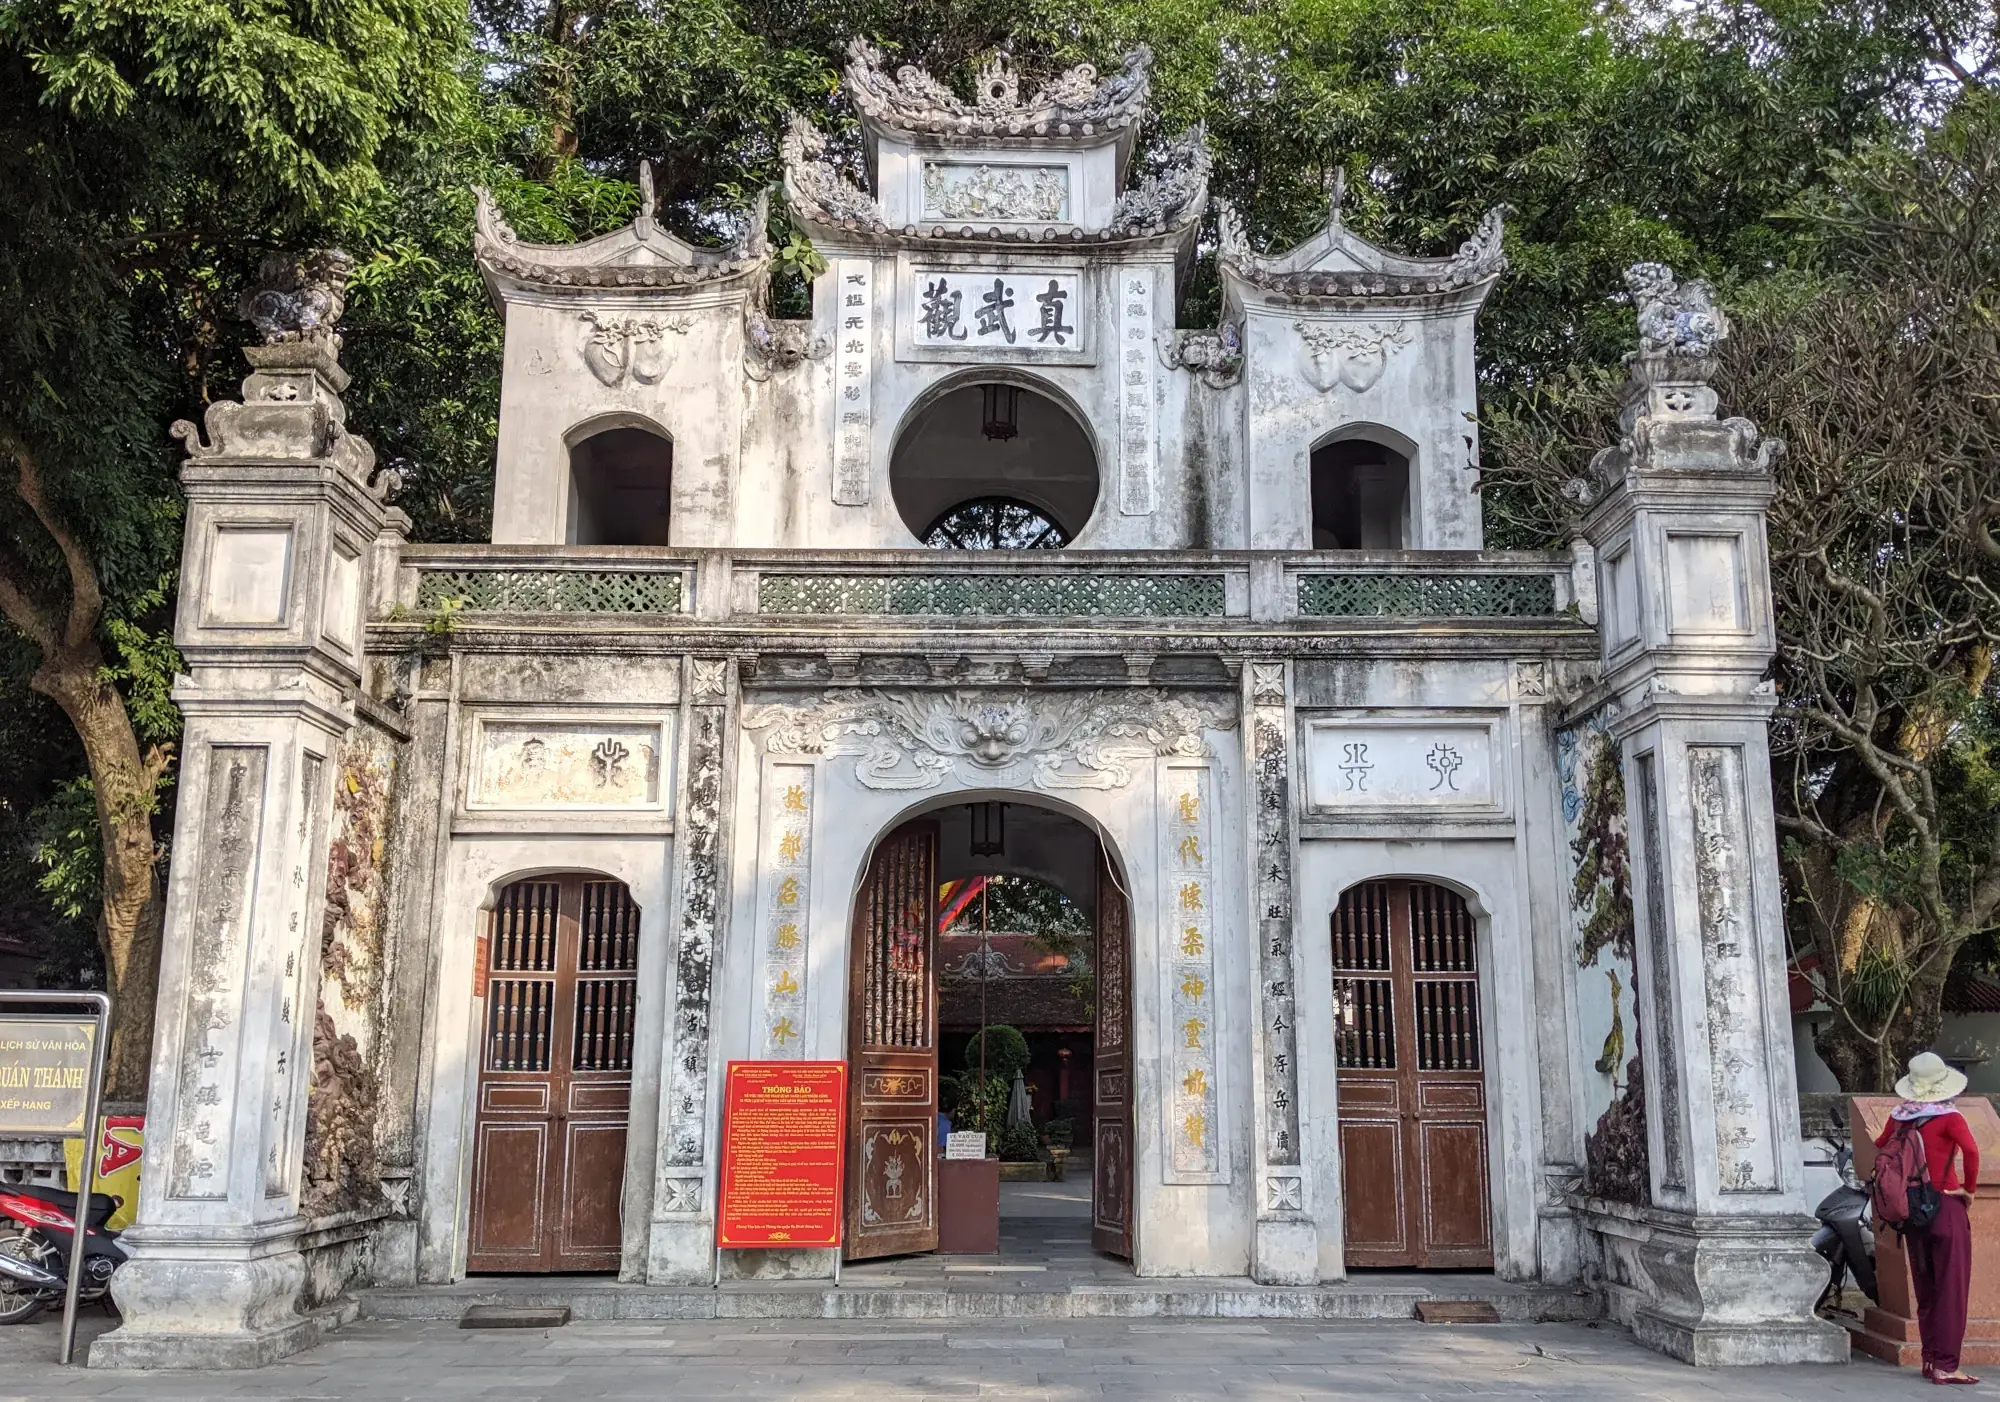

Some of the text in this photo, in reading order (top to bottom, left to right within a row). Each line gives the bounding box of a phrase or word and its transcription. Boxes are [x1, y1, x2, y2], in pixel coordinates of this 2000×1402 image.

[918, 277, 1074, 345] 真武觀
[0, 1041, 23, 1051] LỊCH
[42, 1040, 62, 1051] VĂN
[0, 1060, 84, 1089] UÁN THÁNH
[762, 1085, 792, 1094] THÔNG
[22, 1100, 52, 1112] HẠNG
